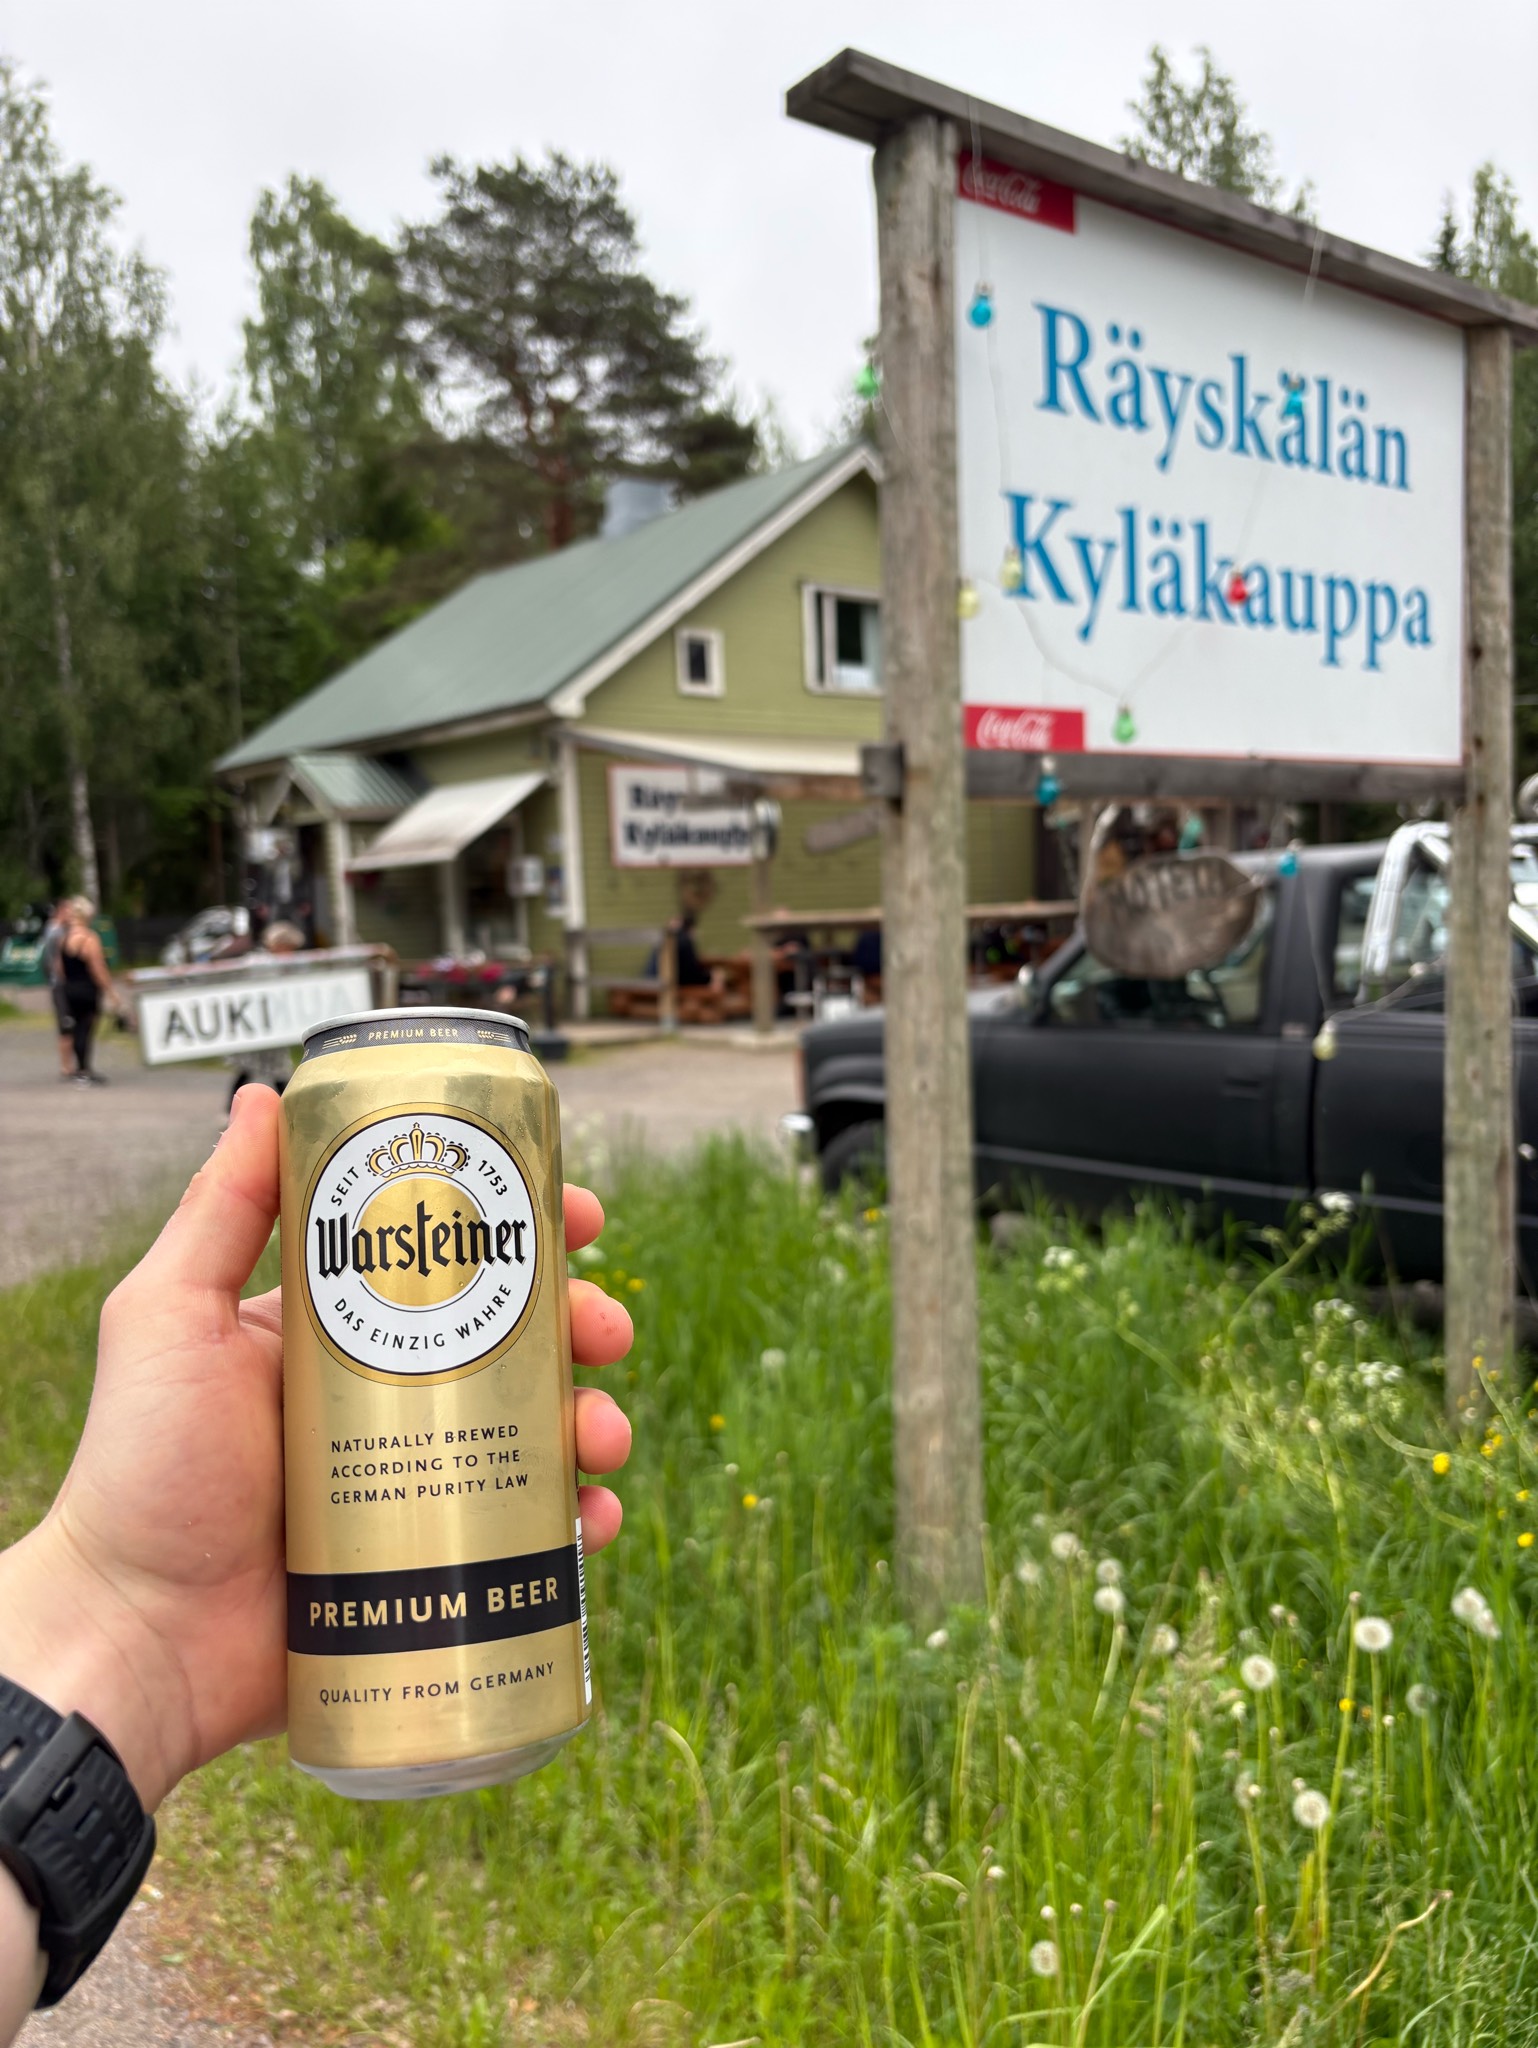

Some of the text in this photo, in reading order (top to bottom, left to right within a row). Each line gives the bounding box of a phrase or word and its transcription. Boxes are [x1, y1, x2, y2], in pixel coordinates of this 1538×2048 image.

[1034, 301, 1412, 493] Räyskälän
[1003, 490, 1433, 671] Kyläkauppa
[165, 996, 271, 1047] AUKI
[368, 1028, 459, 1041] PREMIUM BEER
[331, 1166, 360, 1207] SEIT
[479, 1160, 508, 1196] 1753
[316, 1200, 527, 1279] Warsteiner
[334, 1283, 512, 1350] DAS EINZIG WAHRE
[331, 1425, 520, 1454] NATURALLY BREWED
[331, 1449, 521, 1480] ACCORDING TO THE
[330, 1473, 529, 1505] GERMAN PURITY LAW
[309, 1576, 559, 1628] PREMIUM BEER
[319, 1661, 554, 1706] QUALITY FROM GERMANY
